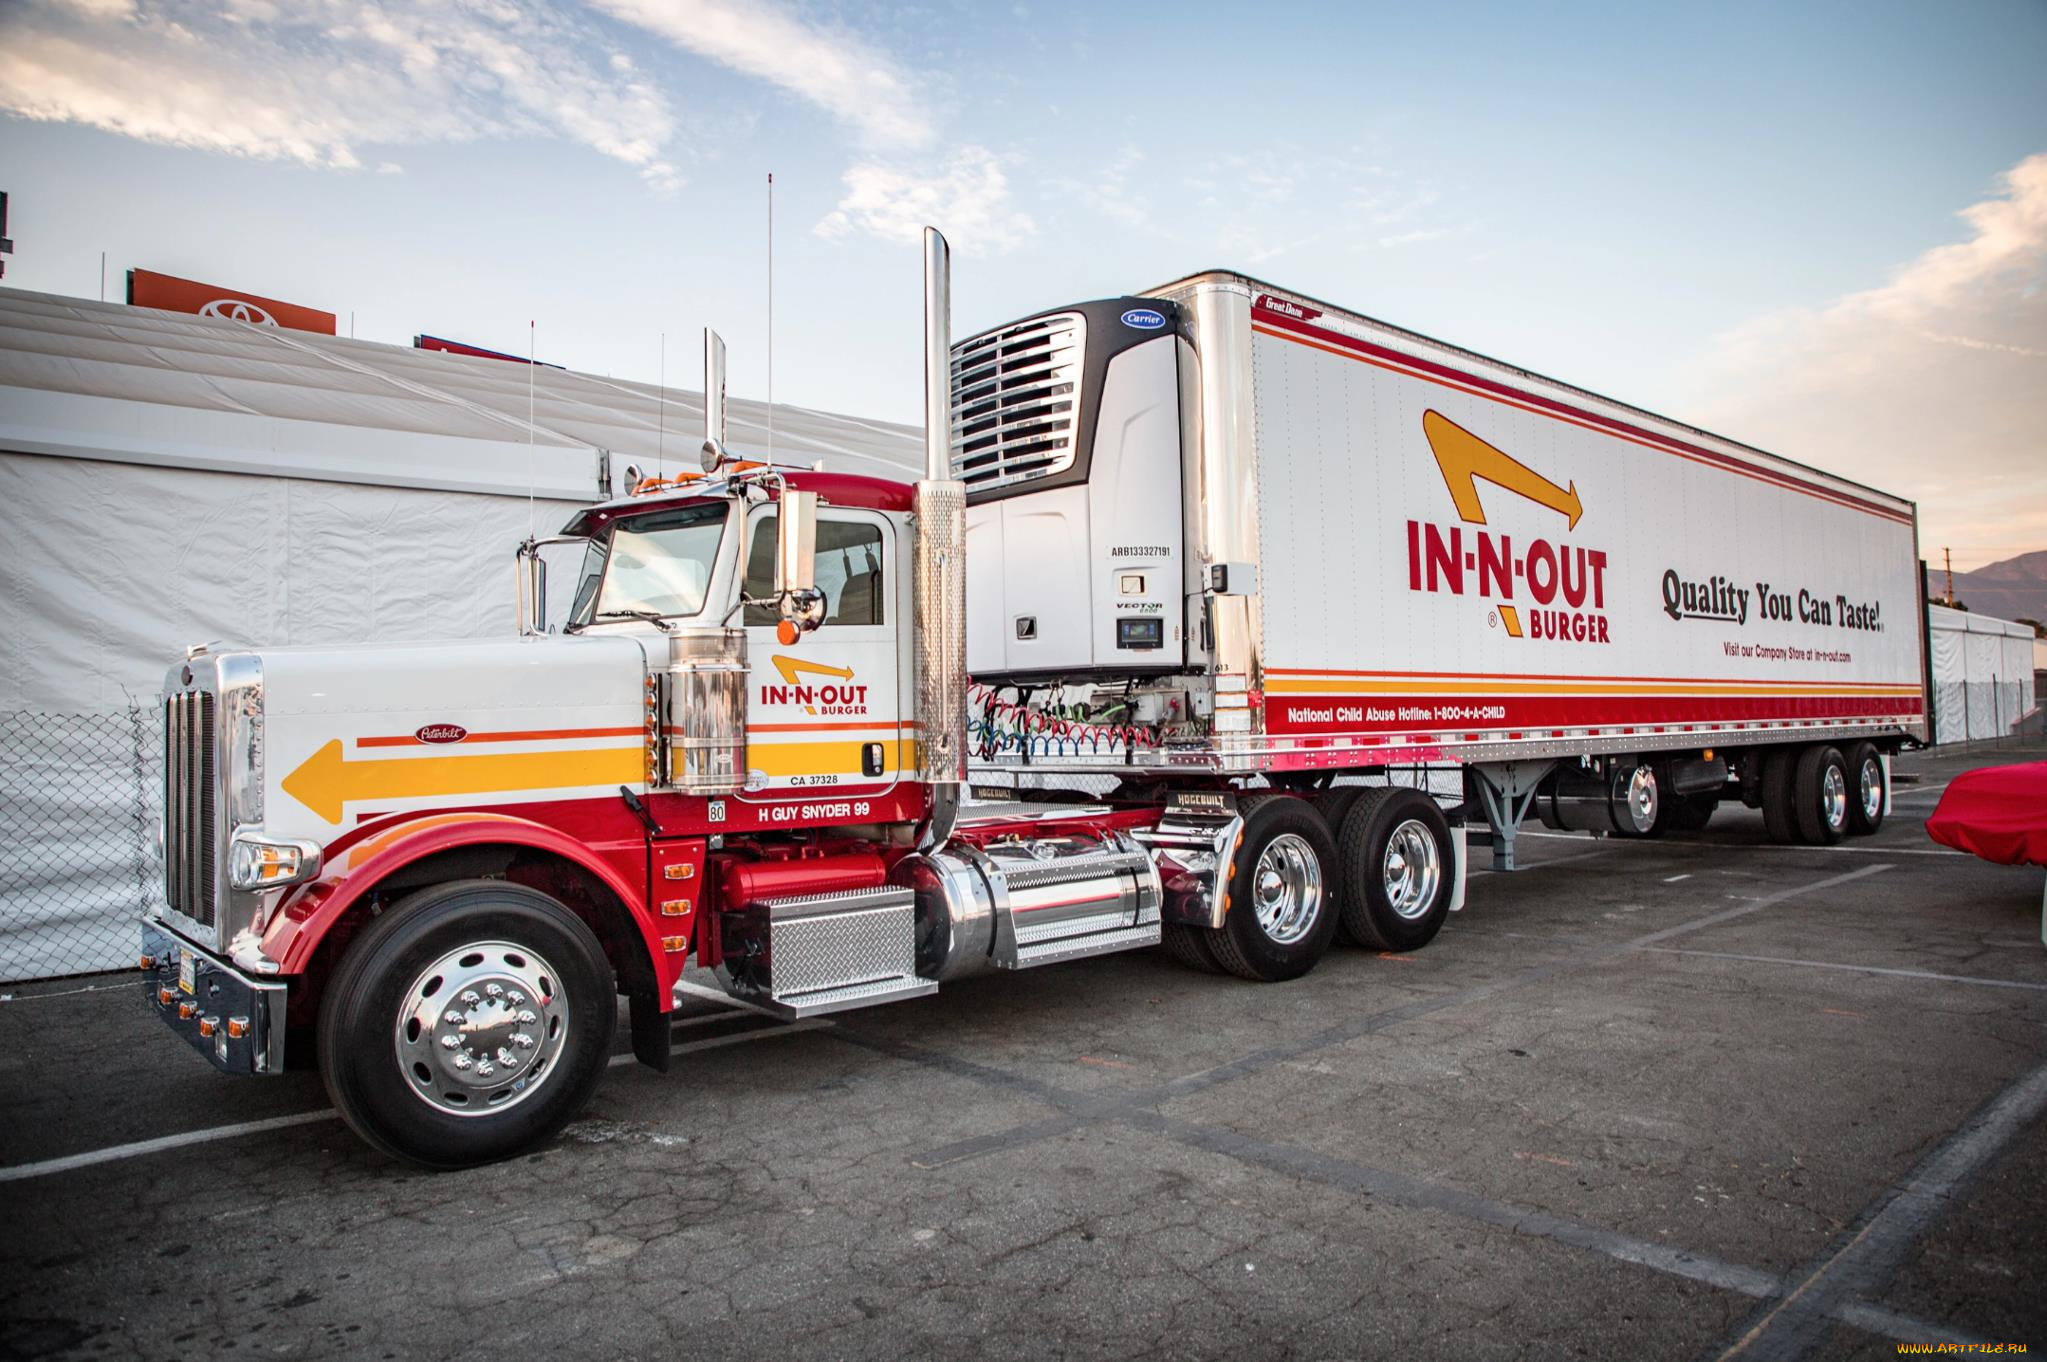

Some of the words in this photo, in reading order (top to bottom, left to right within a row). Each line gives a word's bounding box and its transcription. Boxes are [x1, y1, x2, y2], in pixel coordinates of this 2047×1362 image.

[1266, 297, 1286, 312] Great
[1285, 304, 1303, 318] Dane
[1127, 313, 1161, 325] Carrier
[1111, 546, 1171, 557] ARB133327191
[1407, 519, 1608, 608] IN-N-OUT
[1662, 568, 1749, 626] Quality
[1756, 582, 1793, 621] You
[1799, 588, 1832, 626] Can
[1836, 594, 1881, 632] Taste!
[1530, 608, 1611, 644] BURGER
[1723, 641, 1740, 657] Visit
[1741, 645, 1754, 657] our
[1755, 644, 1787, 661] Company
[1788, 646, 1805, 660] Store
[1806, 648, 1813, 661] at
[1814, 648, 1852, 662] in-n-out.com
[761, 685, 868, 705] IN-N-OUT
[821, 705, 868, 715] BURGER
[1288, 706, 1333, 723] National
[1336, 706, 1363, 723] Child
[1366, 706, 1396, 722] Abuse
[1398, 706, 1432, 721] Hotline:
[1434, 706, 1506, 719] 1-800-4-A-CHILD
[421, 727, 463, 740] Peterbilt
[790, 776, 806, 786] CA
[809, 775, 839, 785] 37328
[710, 806, 724, 821] 80
[758, 807, 769, 822] H
[771, 805, 799, 821] GUY
[801, 803, 851, 820] SNYDER
[854, 801, 870, 816] 99
